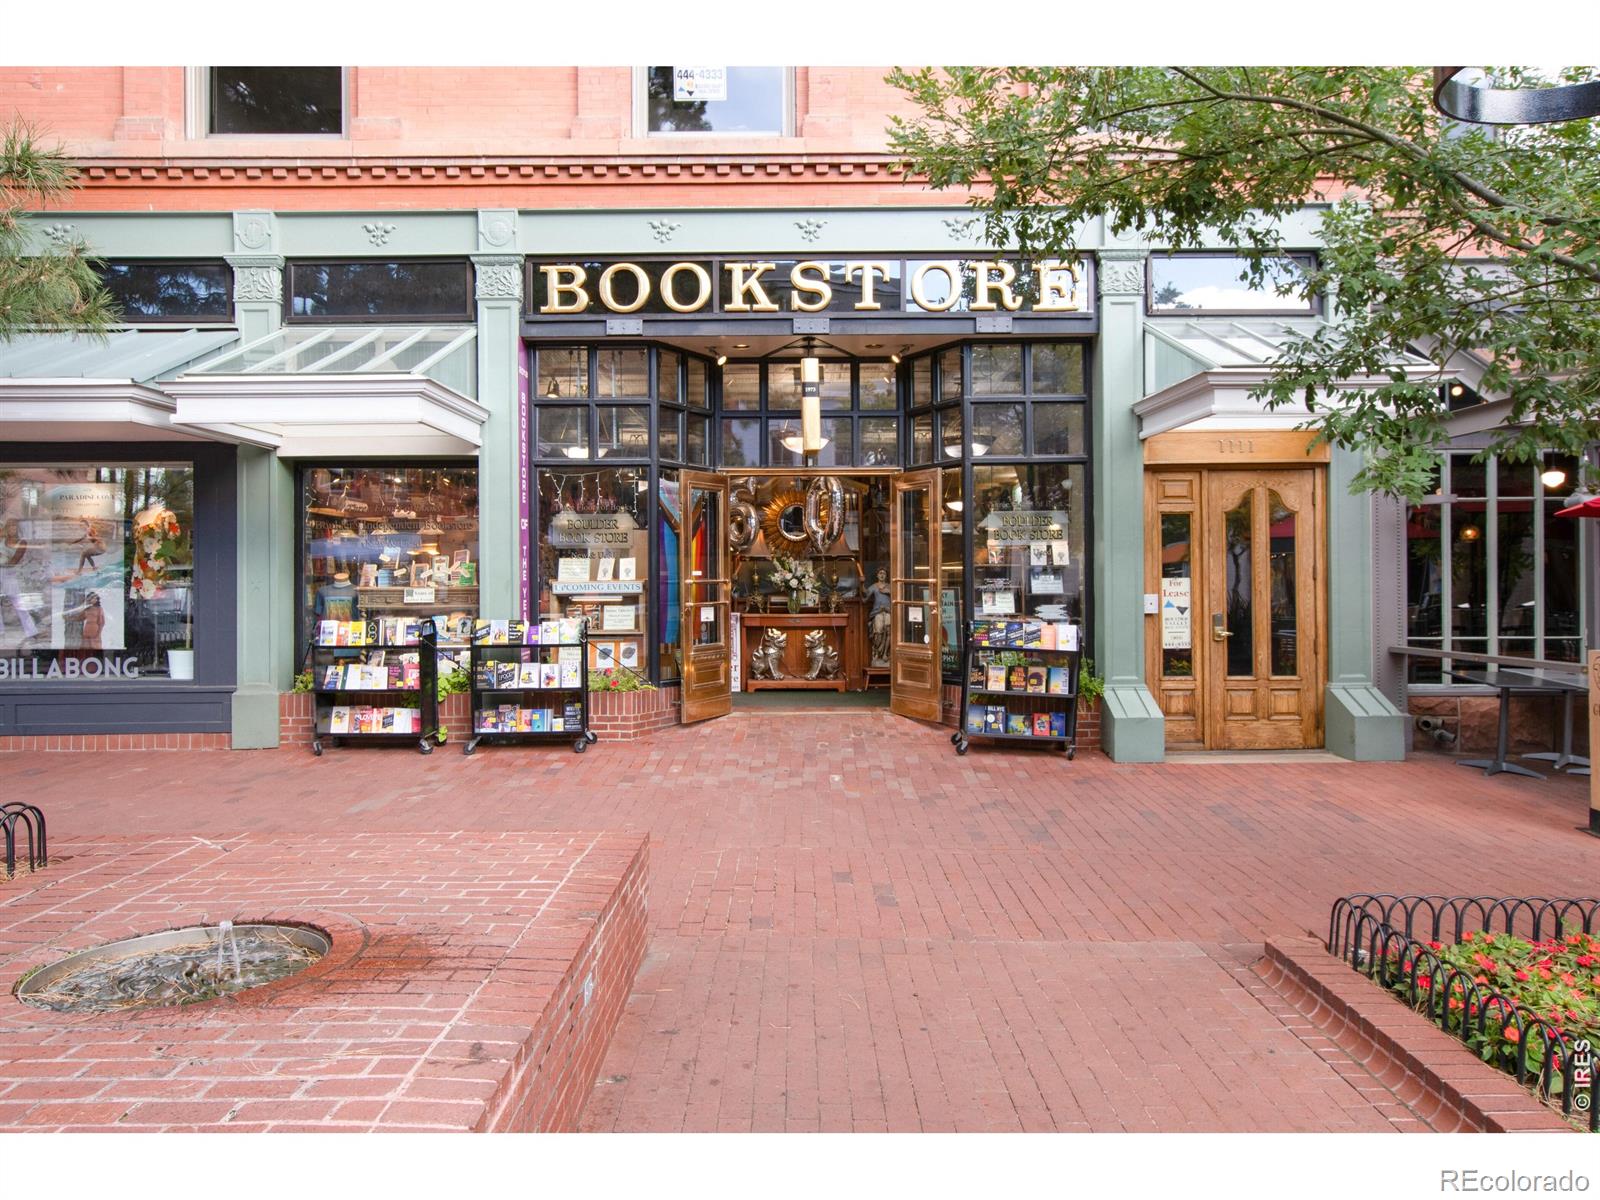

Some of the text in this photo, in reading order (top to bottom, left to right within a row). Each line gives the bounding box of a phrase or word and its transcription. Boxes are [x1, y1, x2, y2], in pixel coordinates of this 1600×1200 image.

[676, 69, 722, 80] 444-4333
[539, 261, 1080, 314] BOOKSTORE
[567, 518, 619, 531] BOULDER
[1003, 514, 1054, 527] BOULDER
[559, 532, 629, 545] BOOK STORE
[994, 529, 1064, 542] BOOK STORE
[554, 583, 641, 592] UPCOMING EVENTS
[1163, 589, 1190, 598] Lease
[0, 657, 139, 679] BILLABONG
